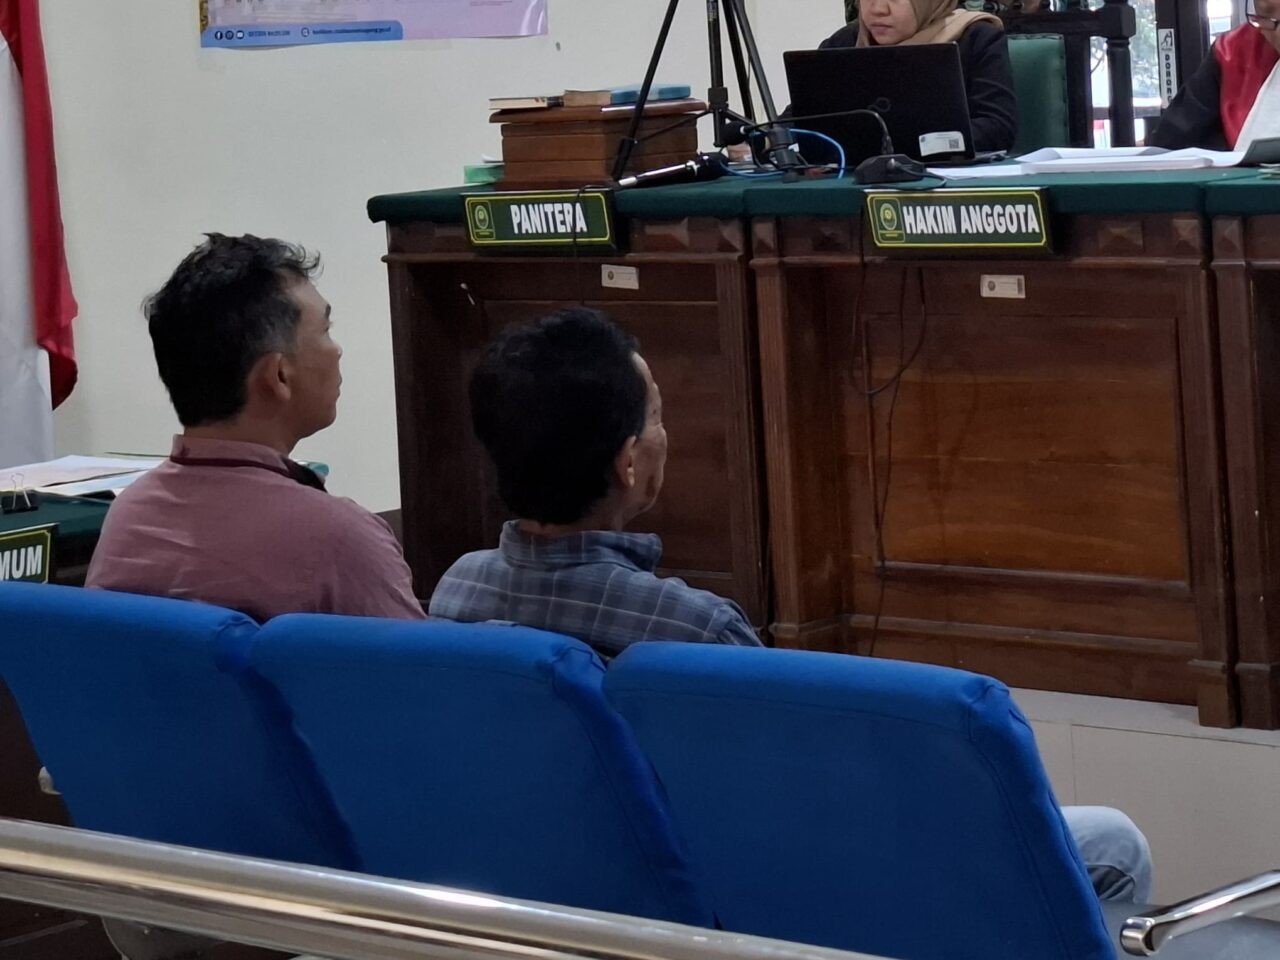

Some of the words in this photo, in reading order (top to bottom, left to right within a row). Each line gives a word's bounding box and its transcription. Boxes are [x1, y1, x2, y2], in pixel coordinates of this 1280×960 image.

[509, 202, 588, 235] PANITERA
[902, 205, 957, 234] HAKIM
[960, 203, 1041, 234] ANGGOTA
